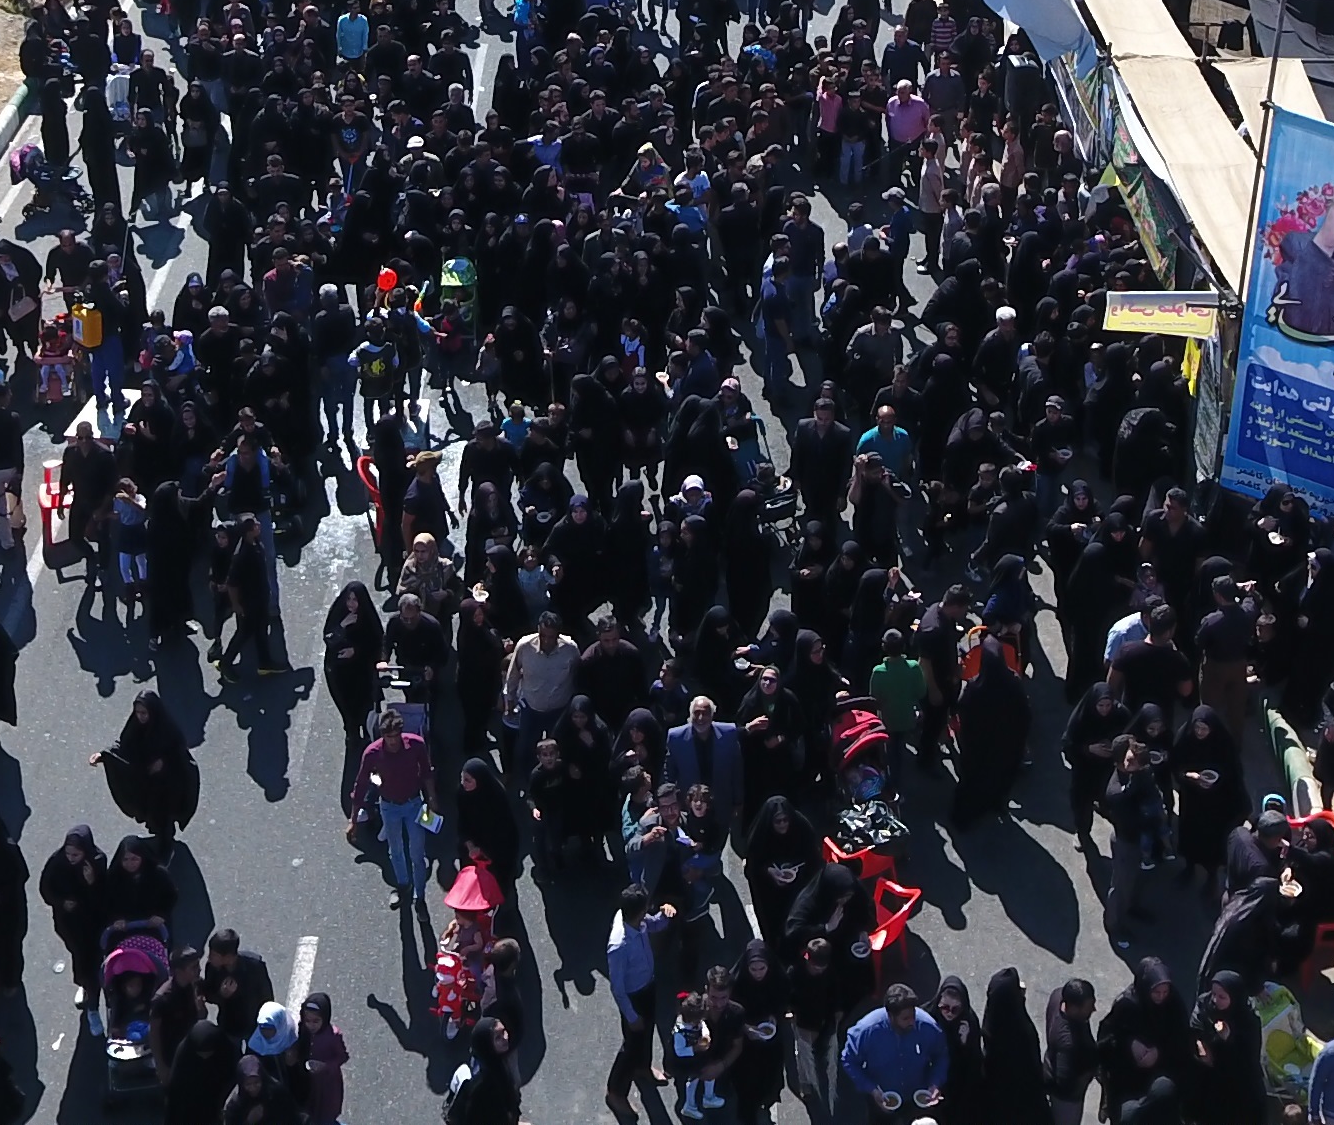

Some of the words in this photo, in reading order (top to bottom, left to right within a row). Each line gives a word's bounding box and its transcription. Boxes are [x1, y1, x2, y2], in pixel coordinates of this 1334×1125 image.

[1251, 376, 1299, 401] هدایت
[1250, 400, 1274, 415] هزینه
[1275, 408, 1285, 420] از
[1285, 415, 1324, 431] قسمتی
[1254, 431, 1296, 450] آموزش
[1287, 428, 1323, 445] مستعد
[1323, 441, 1330, 451] و
